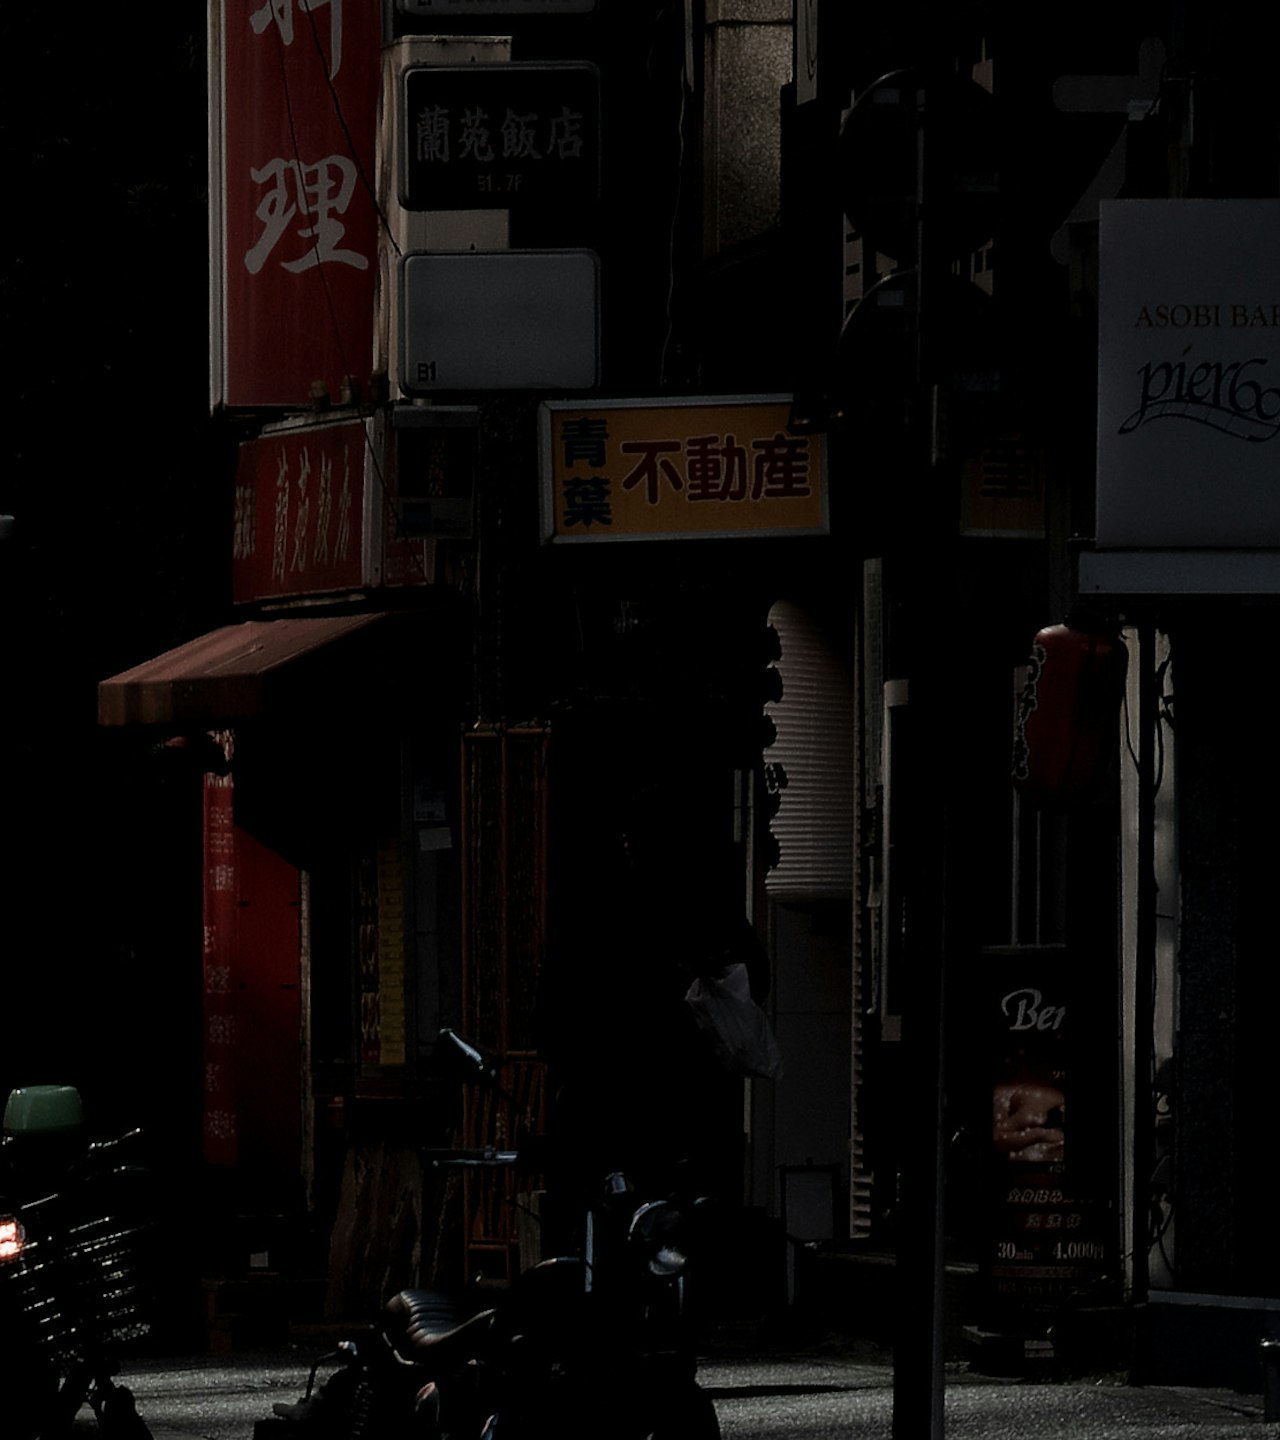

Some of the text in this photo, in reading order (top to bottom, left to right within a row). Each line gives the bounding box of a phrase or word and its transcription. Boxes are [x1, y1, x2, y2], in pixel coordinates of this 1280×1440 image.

[416, 104, 585, 163] 蘭苑飯店
[1135, 305, 1221, 328] ASOBI
[417, 361, 436, 382] B1
[562, 418, 612, 527] 青葉
[621, 434, 812, 504] 不動産
